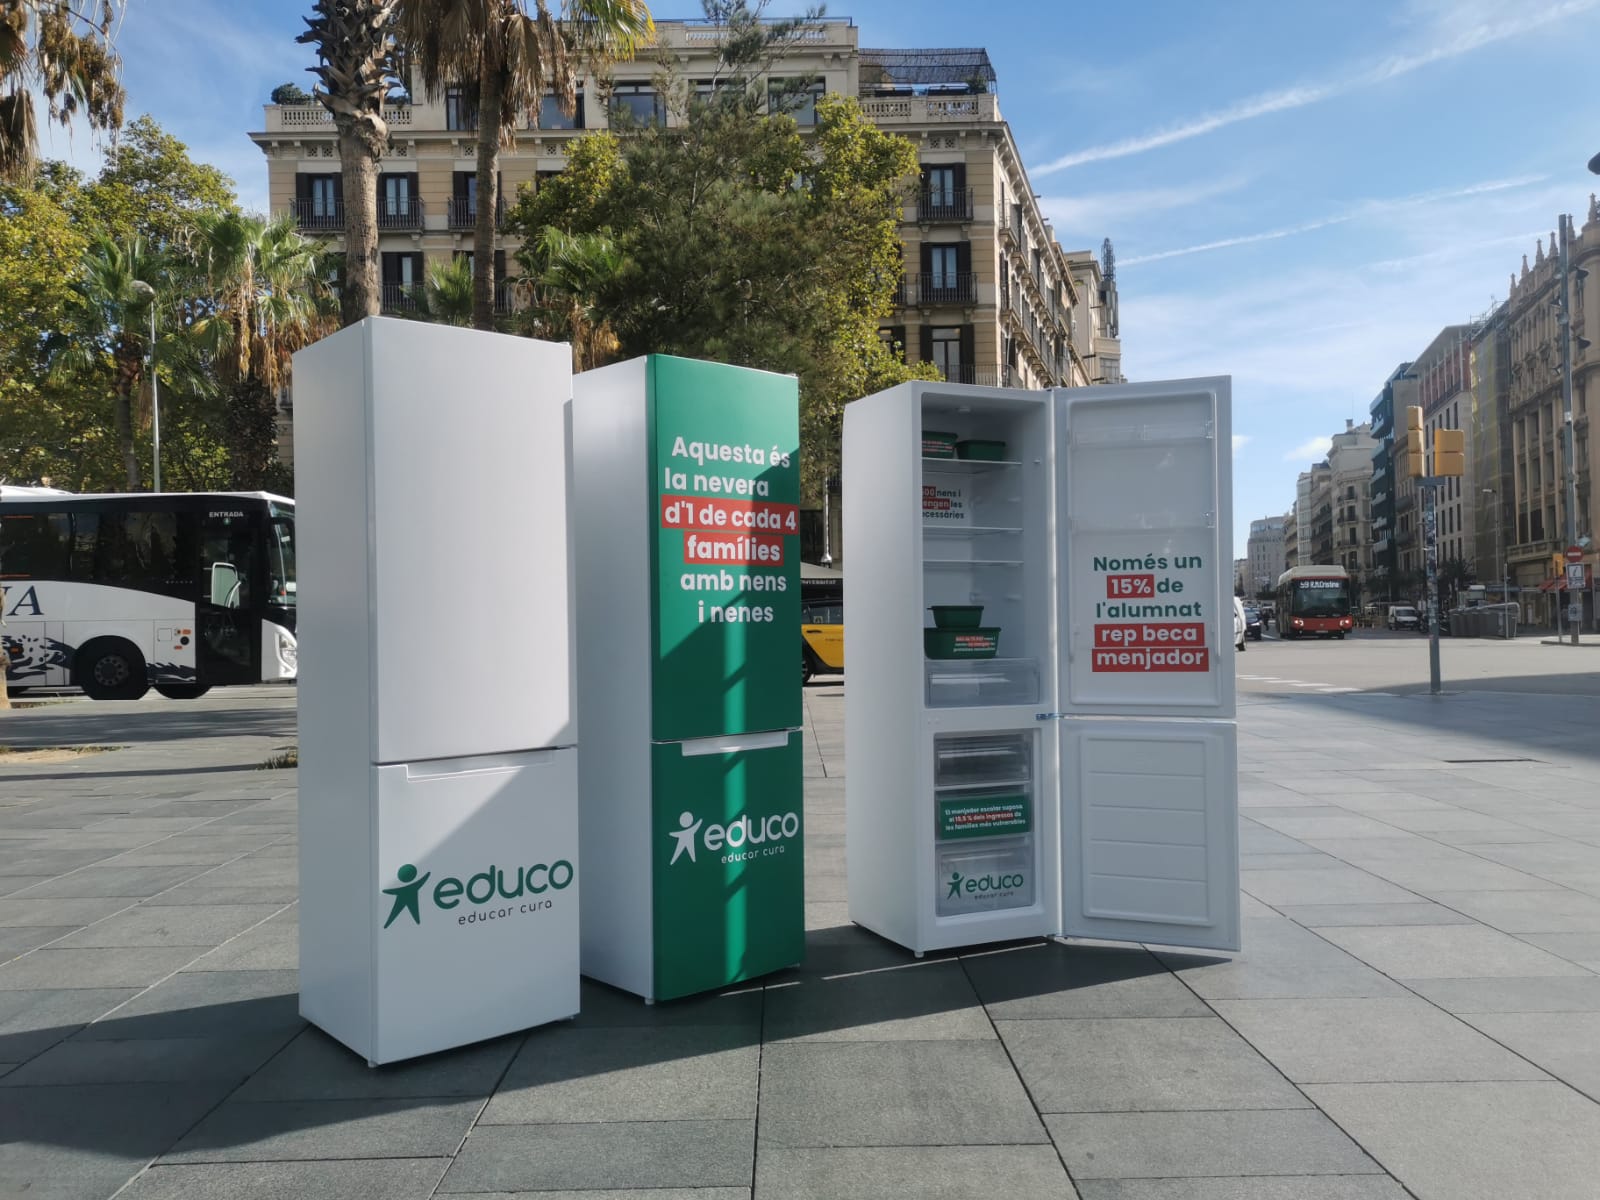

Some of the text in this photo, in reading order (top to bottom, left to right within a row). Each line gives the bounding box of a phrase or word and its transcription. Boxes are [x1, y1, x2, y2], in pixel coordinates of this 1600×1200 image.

[671, 436, 791, 468] Aquesta és
[664, 467, 769, 496] la nevera
[664, 500, 797, 531] d'1 de cada 4
[687, 535, 781, 561] famílies
[1093, 553, 1202, 571] Només un
[680, 569, 787, 592] amb nens
[1111, 577, 1184, 595] 15% de
[698, 600, 774, 623] i nenes
[1096, 601, 1203, 619] l'alumnat
[1101, 625, 1197, 647] rep beca
[1096, 647, 1204, 670] menjador
[704, 812, 799, 851] educo
[721, 845, 785, 864] educar cura
[433, 859, 574, 910] educo
[965, 874, 1024, 893] educo
[458, 899, 553, 925] educar cura
